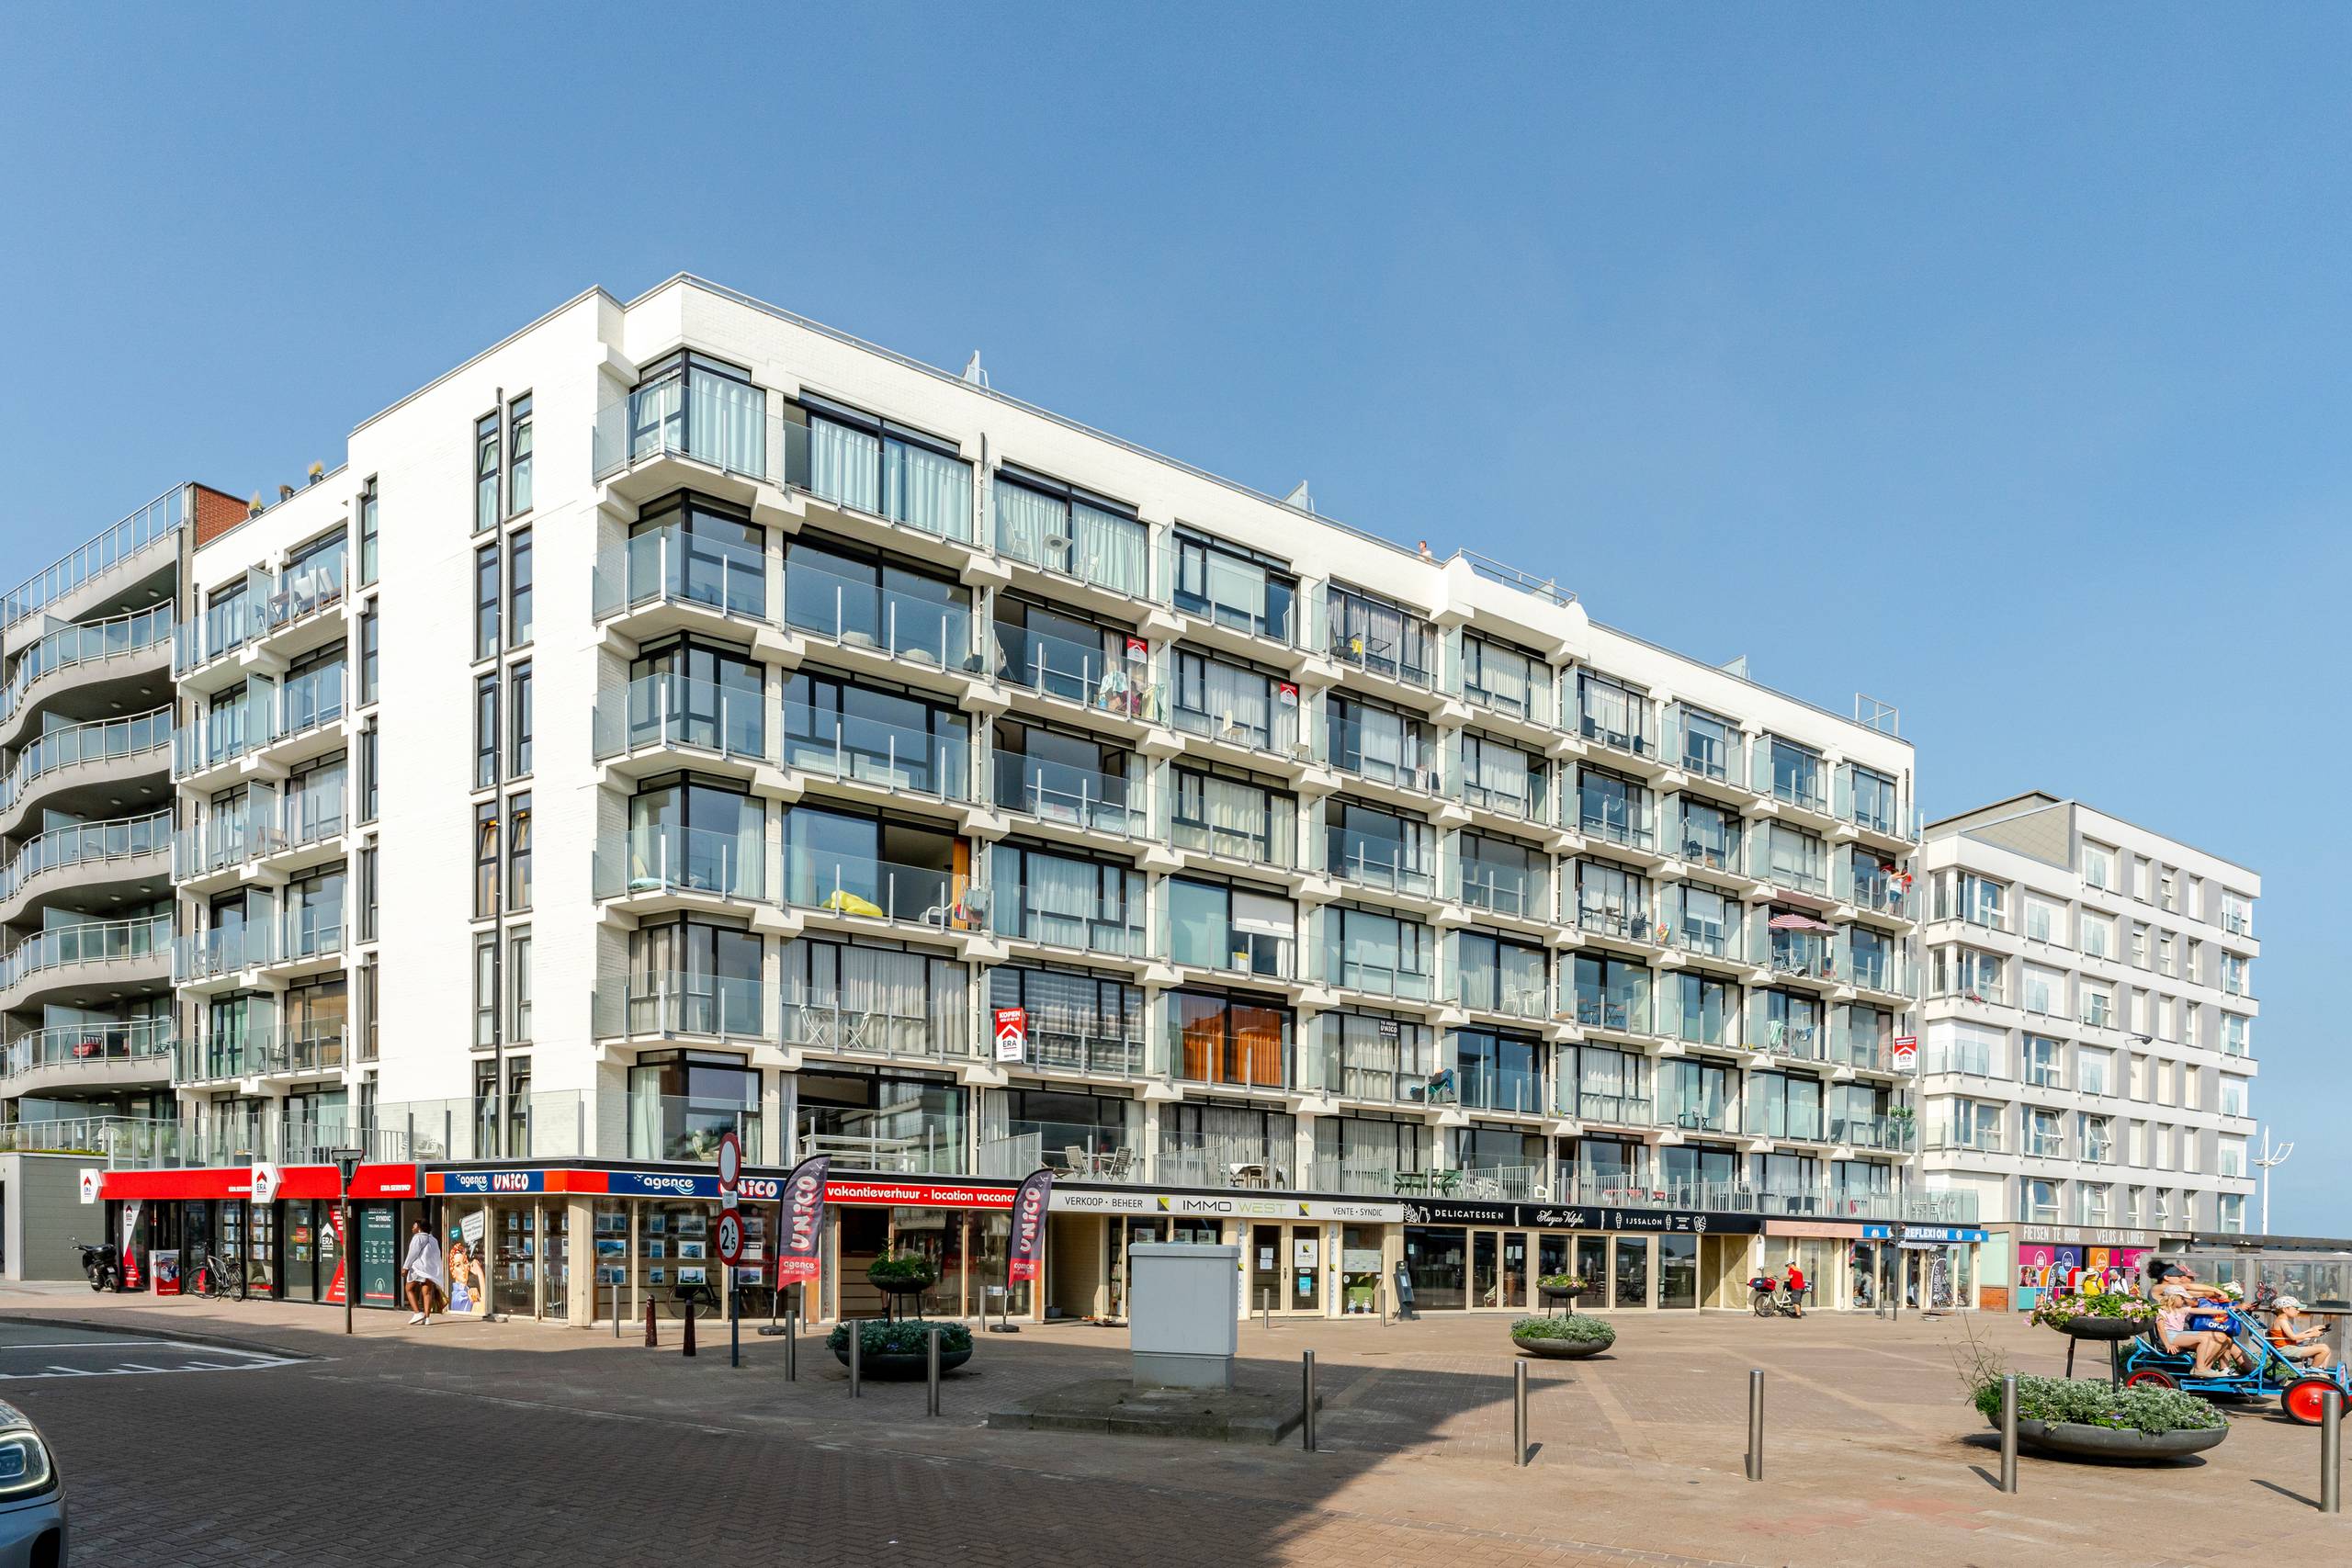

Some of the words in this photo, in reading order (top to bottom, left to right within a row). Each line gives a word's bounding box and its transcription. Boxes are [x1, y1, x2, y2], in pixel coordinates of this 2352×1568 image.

[460, 1175, 488, 1188] agence
[644, 1177, 695, 1190] agence
[827, 1186, 921, 1200] vakantieverhuur
[931, 1190, 974, 1201] location
[1065, 1196, 1103, 1206] VERKOOP
[1112, 1199, 1143, 1208] BEHEER
[1182, 1200, 1232, 1213] IMMO
[1238, 1202, 1287, 1214] WEST
[1332, 1206, 1354, 1216] VENTE
[1360, 1207, 1383, 1217] SYNDIC
[1434, 1210, 1504, 1220] DELICATESSEN
[1625, 1217, 1662, 1225] IJSSALON
[1905, 1227, 1949, 1239] REFLEXION
[2023, 1226, 2049, 1241] FIETSEN
[2052, 1227, 2061, 1242] TE
[322, 1236, 334, 1245] ERA
[784, 1260, 816, 1270] agence
